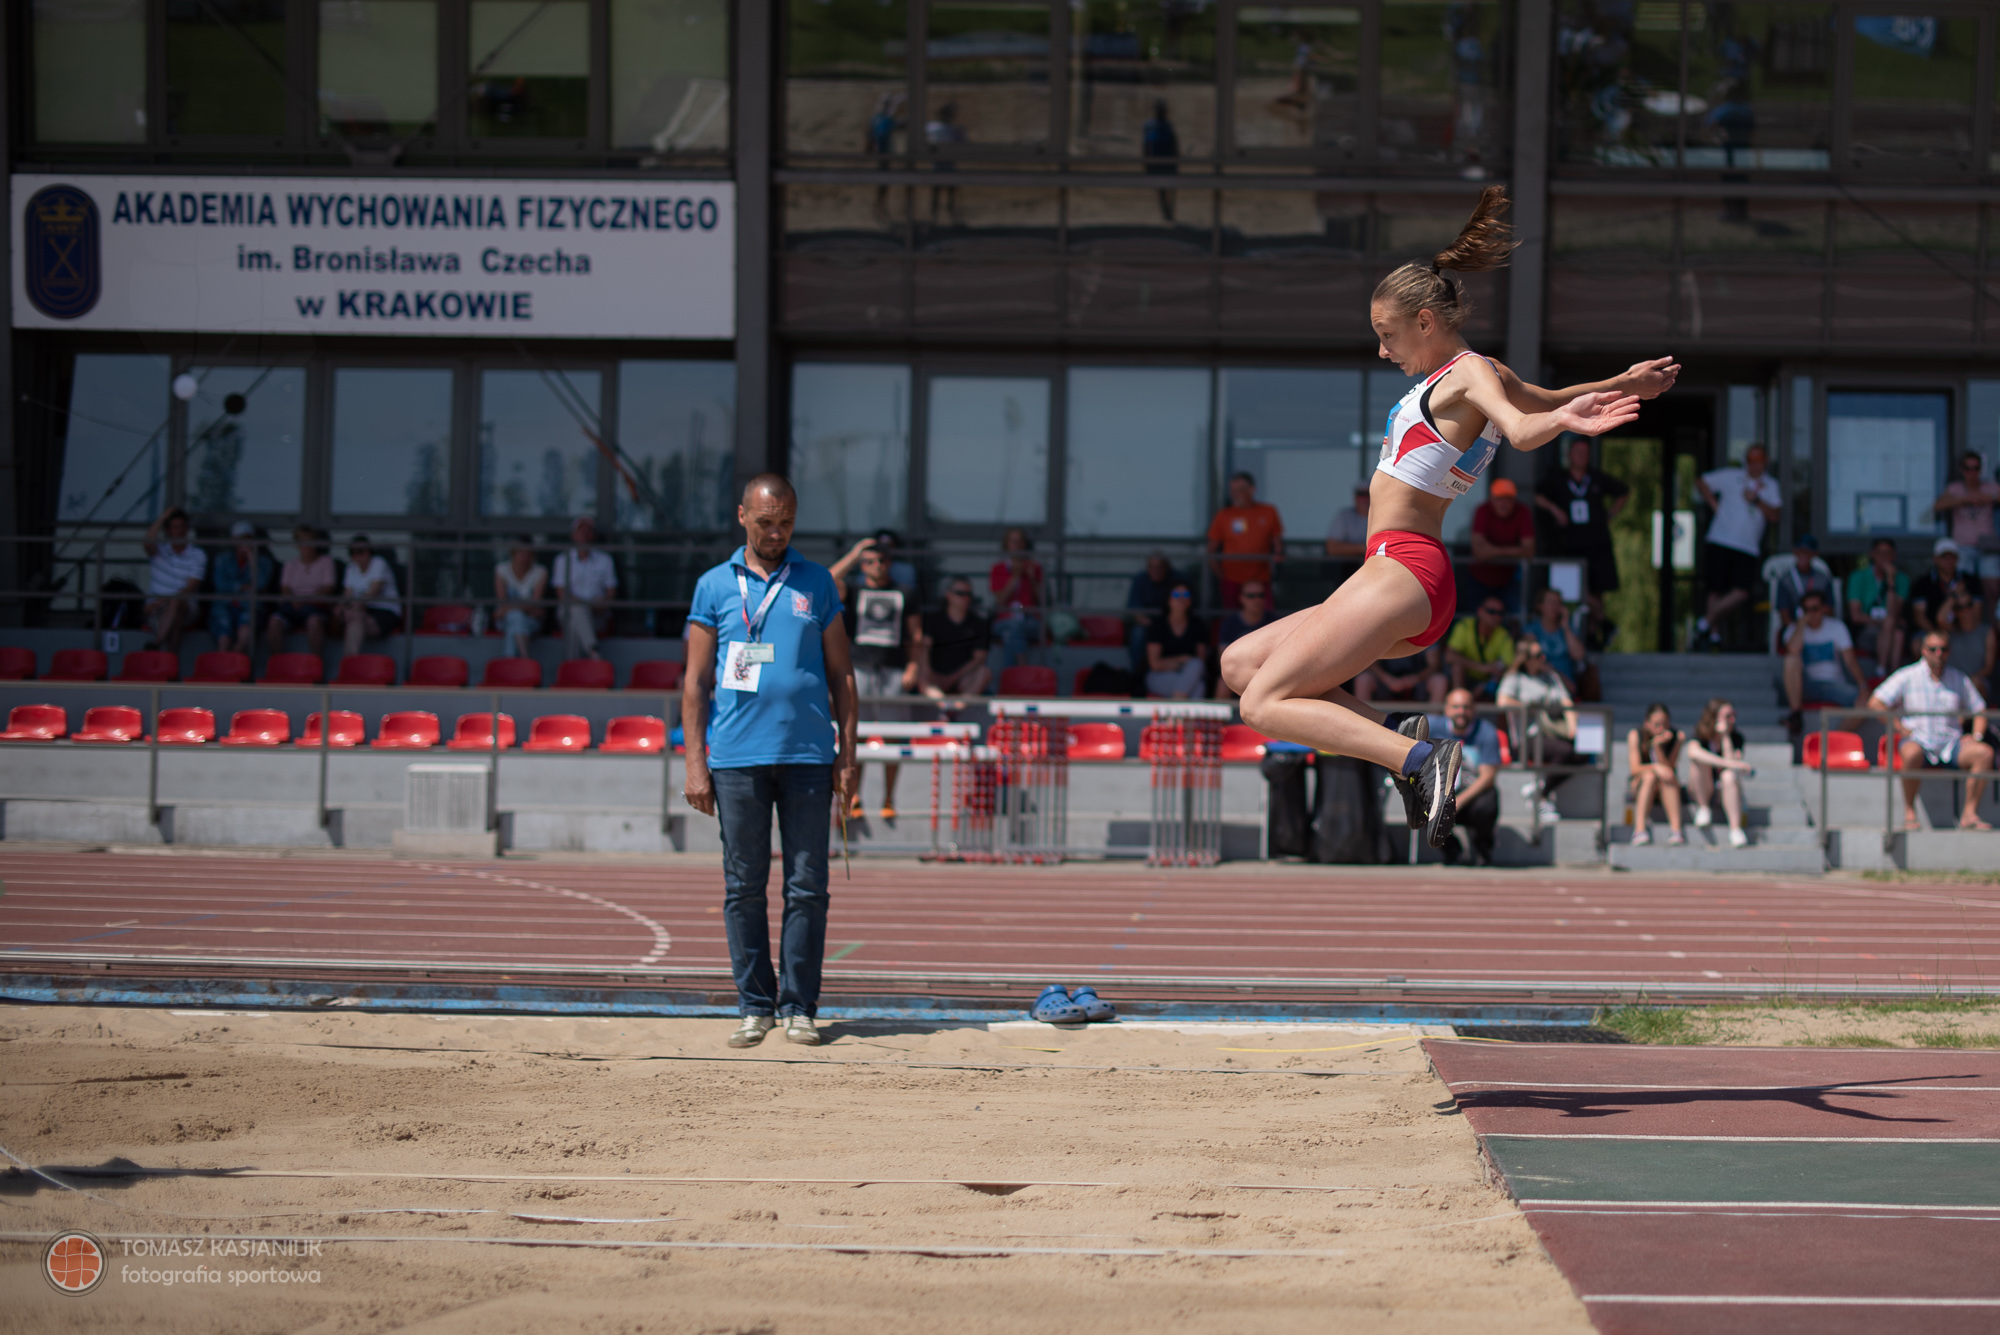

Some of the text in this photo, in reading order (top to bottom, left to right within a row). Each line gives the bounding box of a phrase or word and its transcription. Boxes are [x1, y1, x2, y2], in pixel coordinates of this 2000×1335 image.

[112, 191, 719, 232] AKADEMIA WYCHOWANIA FIZYCZNEGO
[238, 244, 592, 275] im. Bronisława Czecha
[296, 291, 532, 320] w KRAKOWIE
